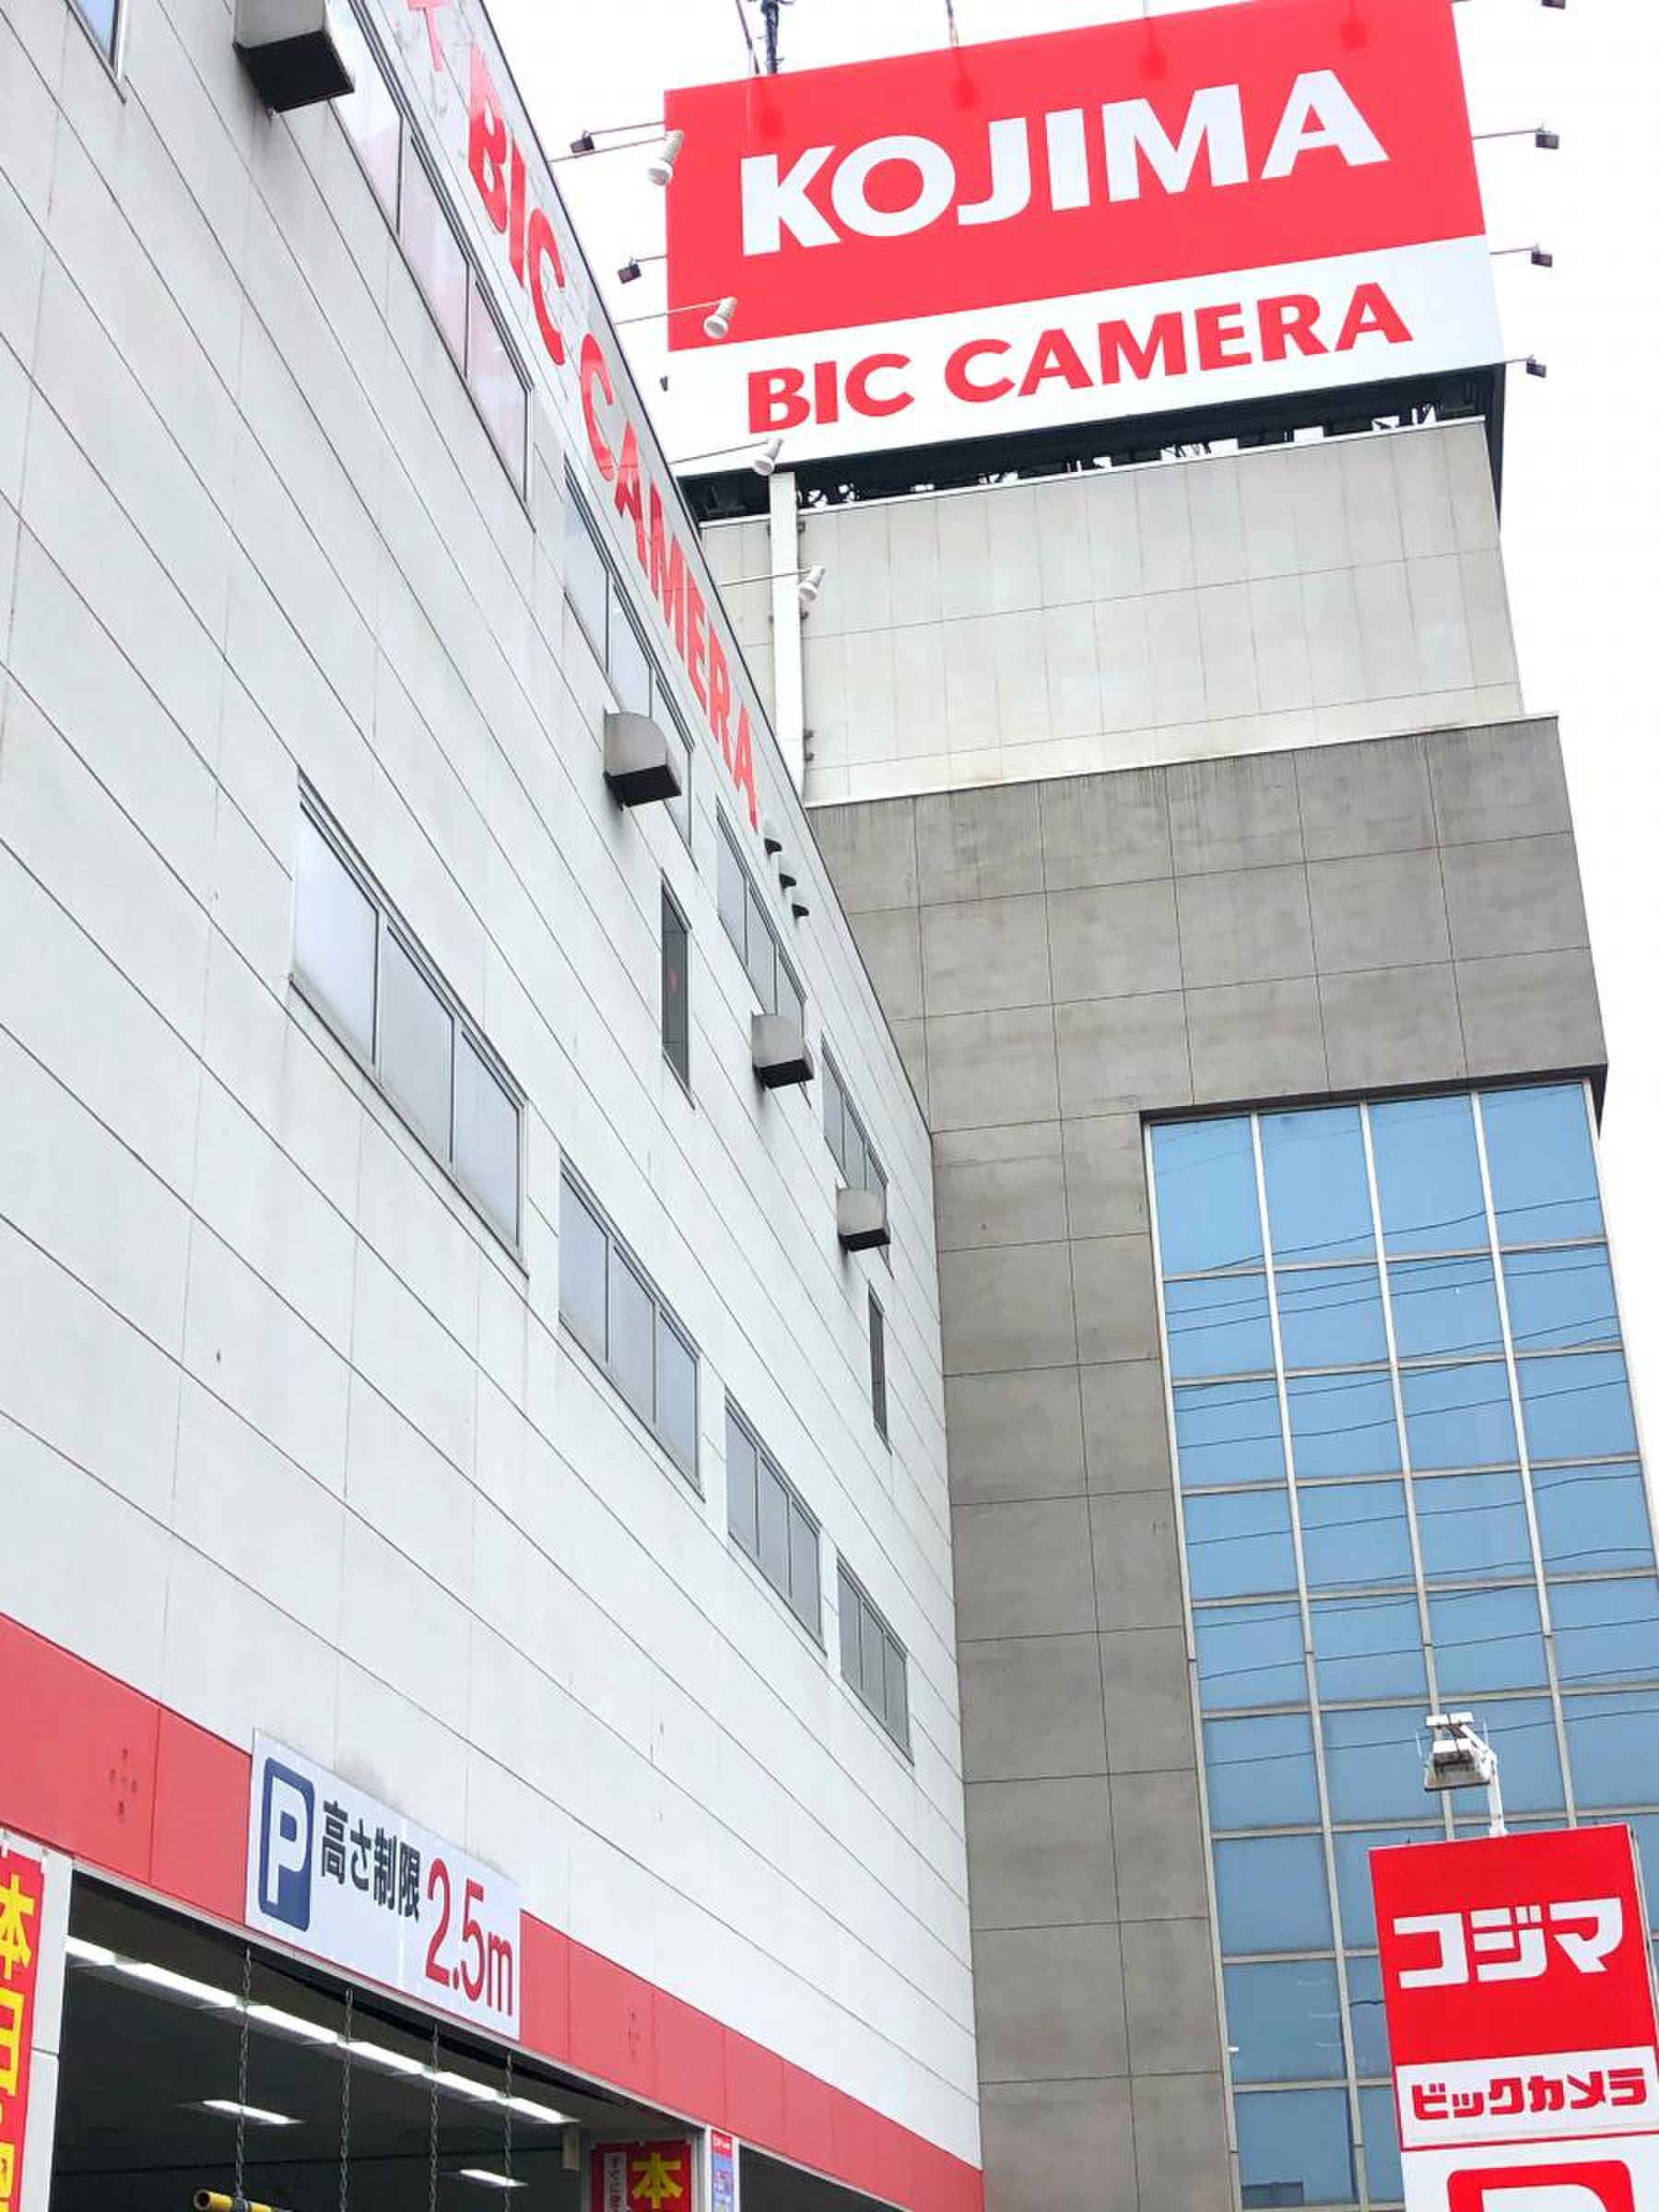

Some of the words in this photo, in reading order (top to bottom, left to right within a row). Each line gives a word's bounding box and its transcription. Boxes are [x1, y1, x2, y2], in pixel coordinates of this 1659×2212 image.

[740, 69, 1390, 257] KOJIMA
[747, 353, 915, 435] BIC
[942, 281, 1414, 404] CAMERA
[468, 42, 566, 367] BIC
[579, 332, 759, 830] CAMERA
[265, 1775, 309, 1905] P
[321, 1800, 421, 1924] 高さ制限
[425, 1857, 513, 2017] 2.5m
[1393, 1897, 1624, 1990] コジマ
[1410, 2066, 1648, 2122] ビックカメラ
[631, 2152, 684, 2209] 本
